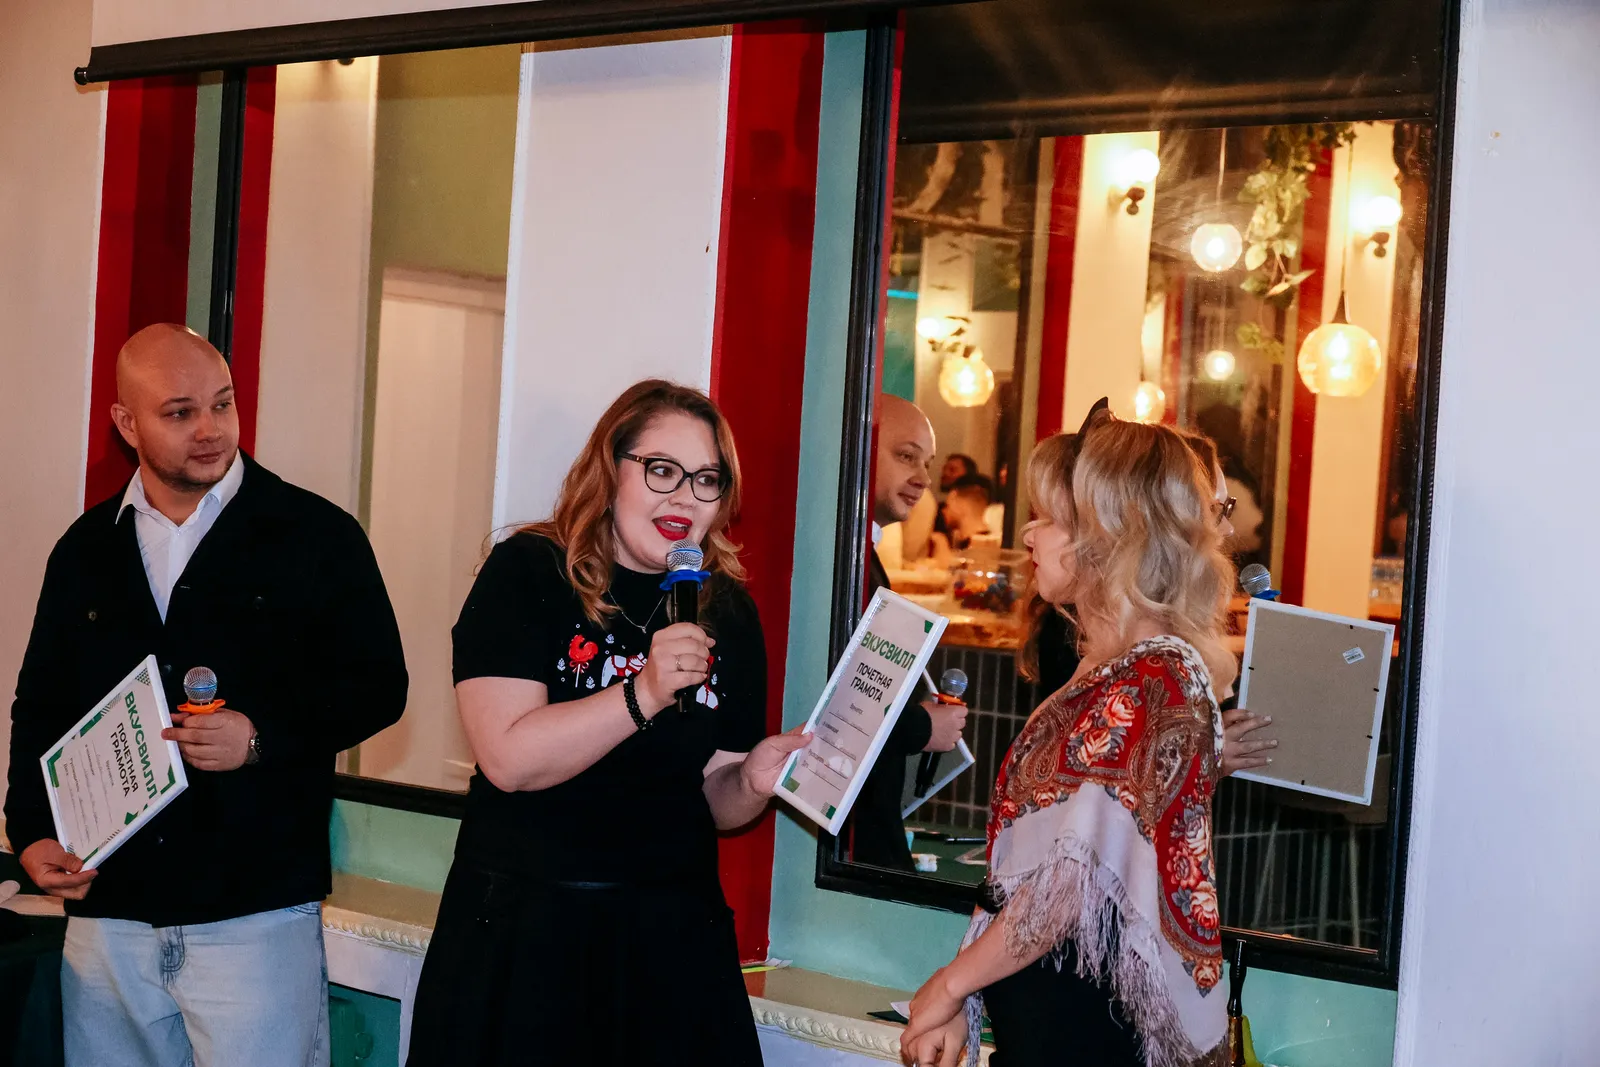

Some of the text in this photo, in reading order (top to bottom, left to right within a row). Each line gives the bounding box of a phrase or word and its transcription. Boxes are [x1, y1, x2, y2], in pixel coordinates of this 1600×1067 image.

[856, 662, 893, 689] ПОЧЕТНАЯ
[861, 631, 916, 671] ВКУСВИЛЛ
[850, 676, 883, 703] ГРАМОТА
[110, 732, 130, 797] ГРАМОТА
[116, 722, 139, 793] ПОЧЕТНАЯ
[124, 691, 158, 799] ВКУСВИЛЛ
